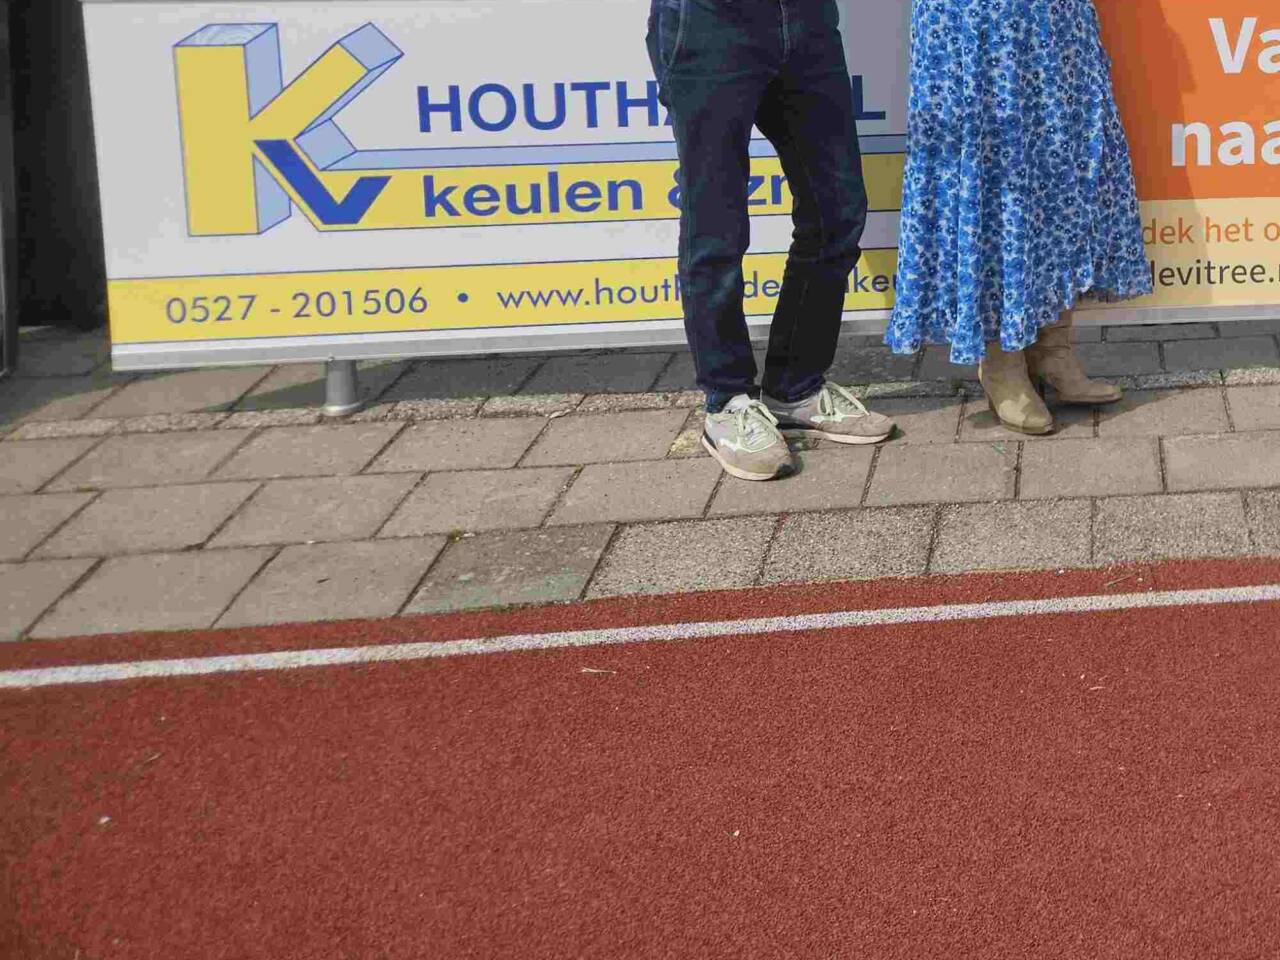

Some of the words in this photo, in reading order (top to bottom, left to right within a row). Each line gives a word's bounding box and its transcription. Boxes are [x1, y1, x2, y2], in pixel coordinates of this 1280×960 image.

[422, 171, 644, 218] keulen
[1204, 217, 1254, 243] het
[165, 294, 257, 323] 0527
[291, 286, 428, 318] 201506
